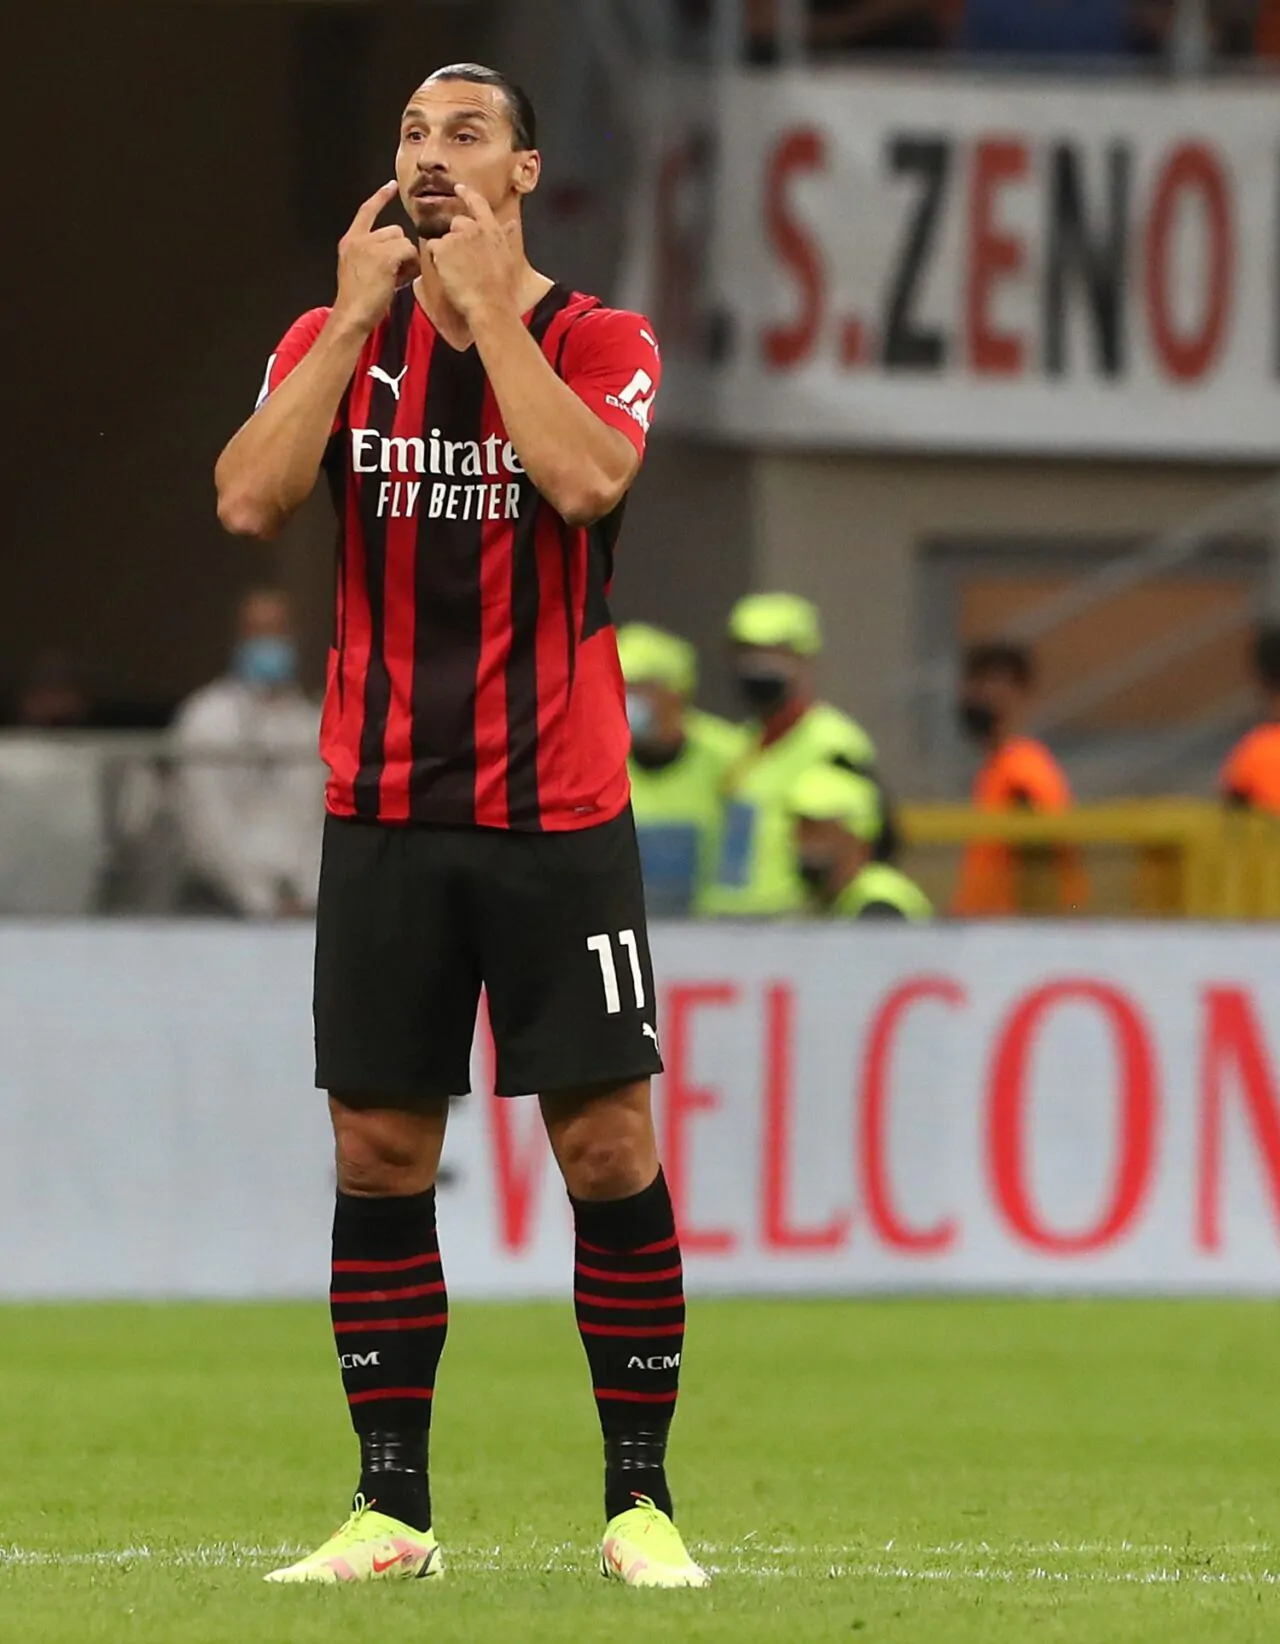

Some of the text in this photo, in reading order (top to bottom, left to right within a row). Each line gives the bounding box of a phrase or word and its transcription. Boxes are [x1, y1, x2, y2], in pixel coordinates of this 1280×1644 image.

[350, 428, 526, 476] Emirate
[376, 481, 521, 520] FLY BETTER
[587, 929, 646, 1014] 11
[338, 1351, 381, 1369] CM
[627, 1352, 681, 1370] ACM
